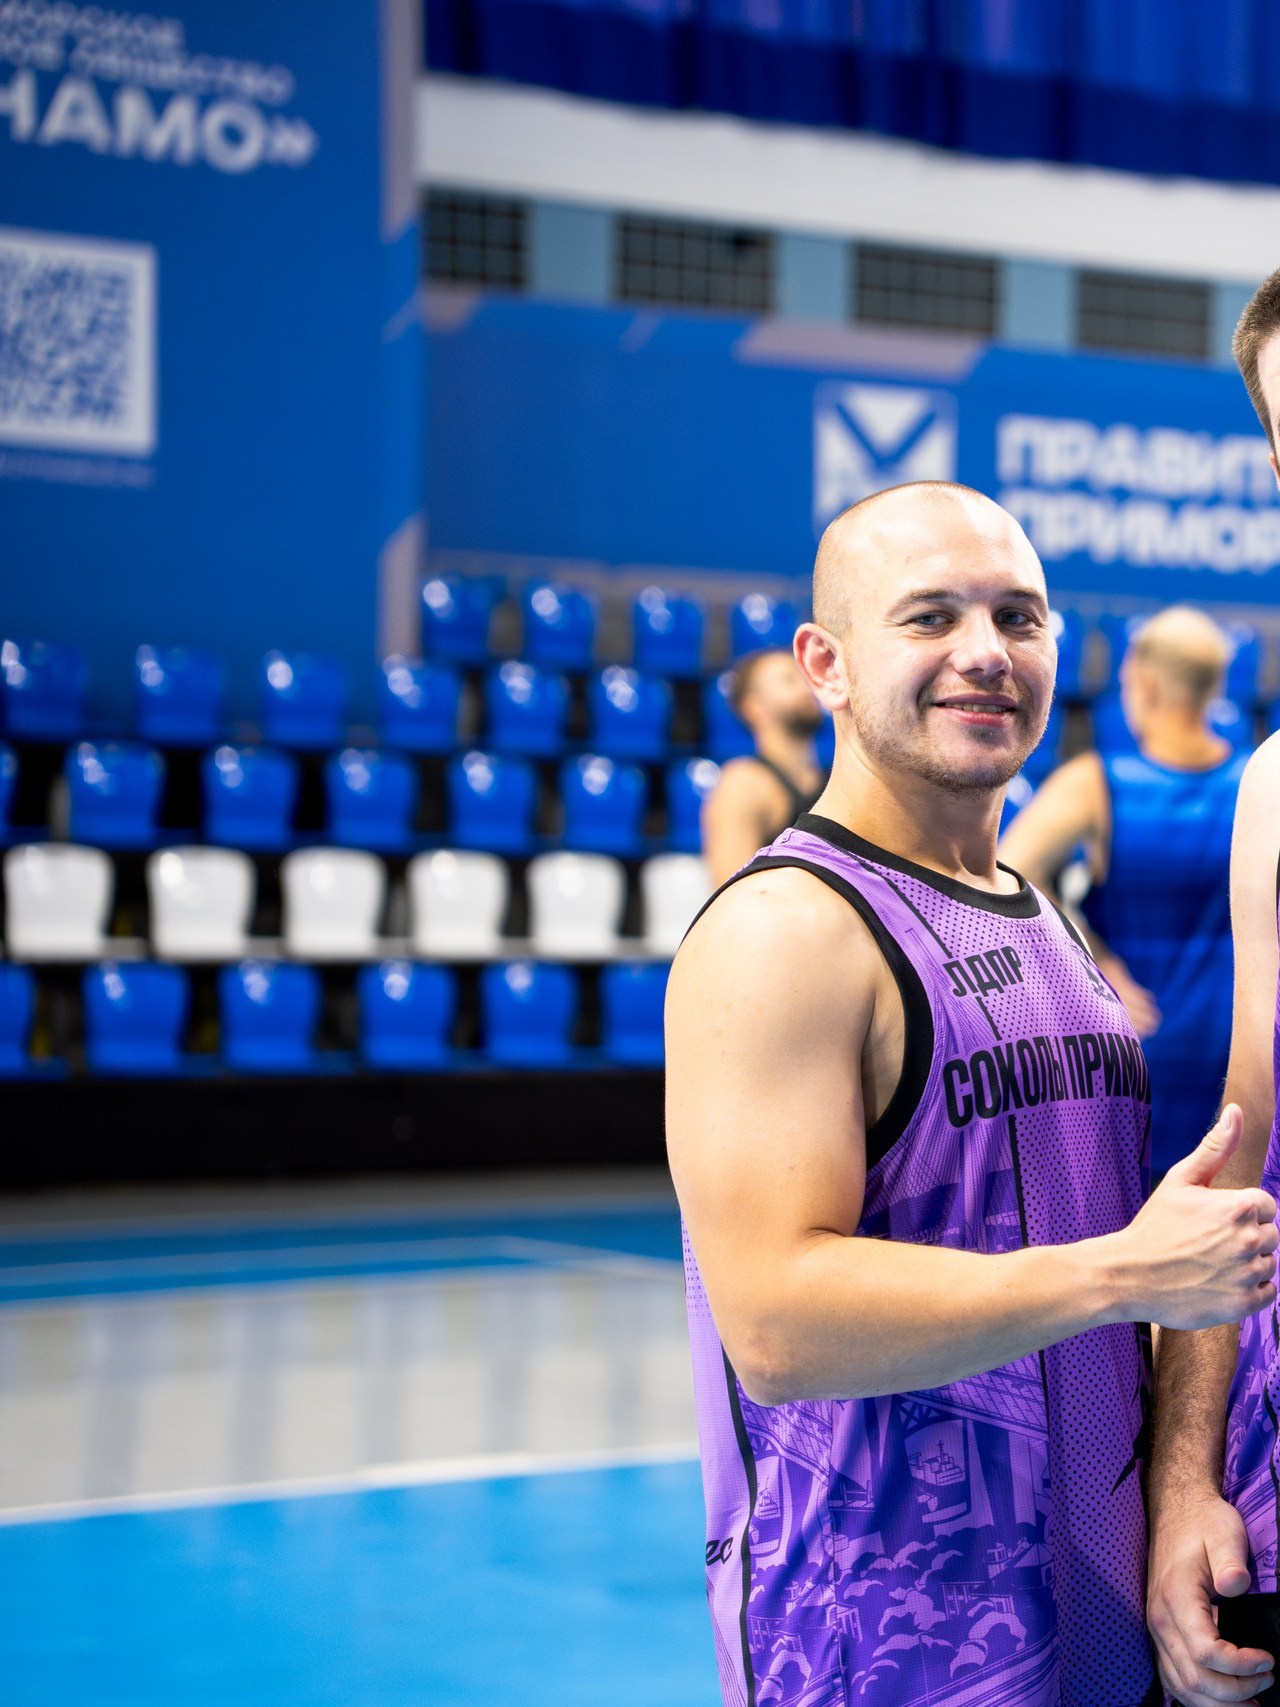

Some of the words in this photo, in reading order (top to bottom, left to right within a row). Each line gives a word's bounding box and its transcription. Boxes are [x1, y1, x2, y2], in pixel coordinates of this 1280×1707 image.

[943, 945, 1024, 997] ЛДПР
[943, 1035, 1070, 1128] СОКОЛЫ
[1062, 1032, 1151, 1105] ПРИМО
